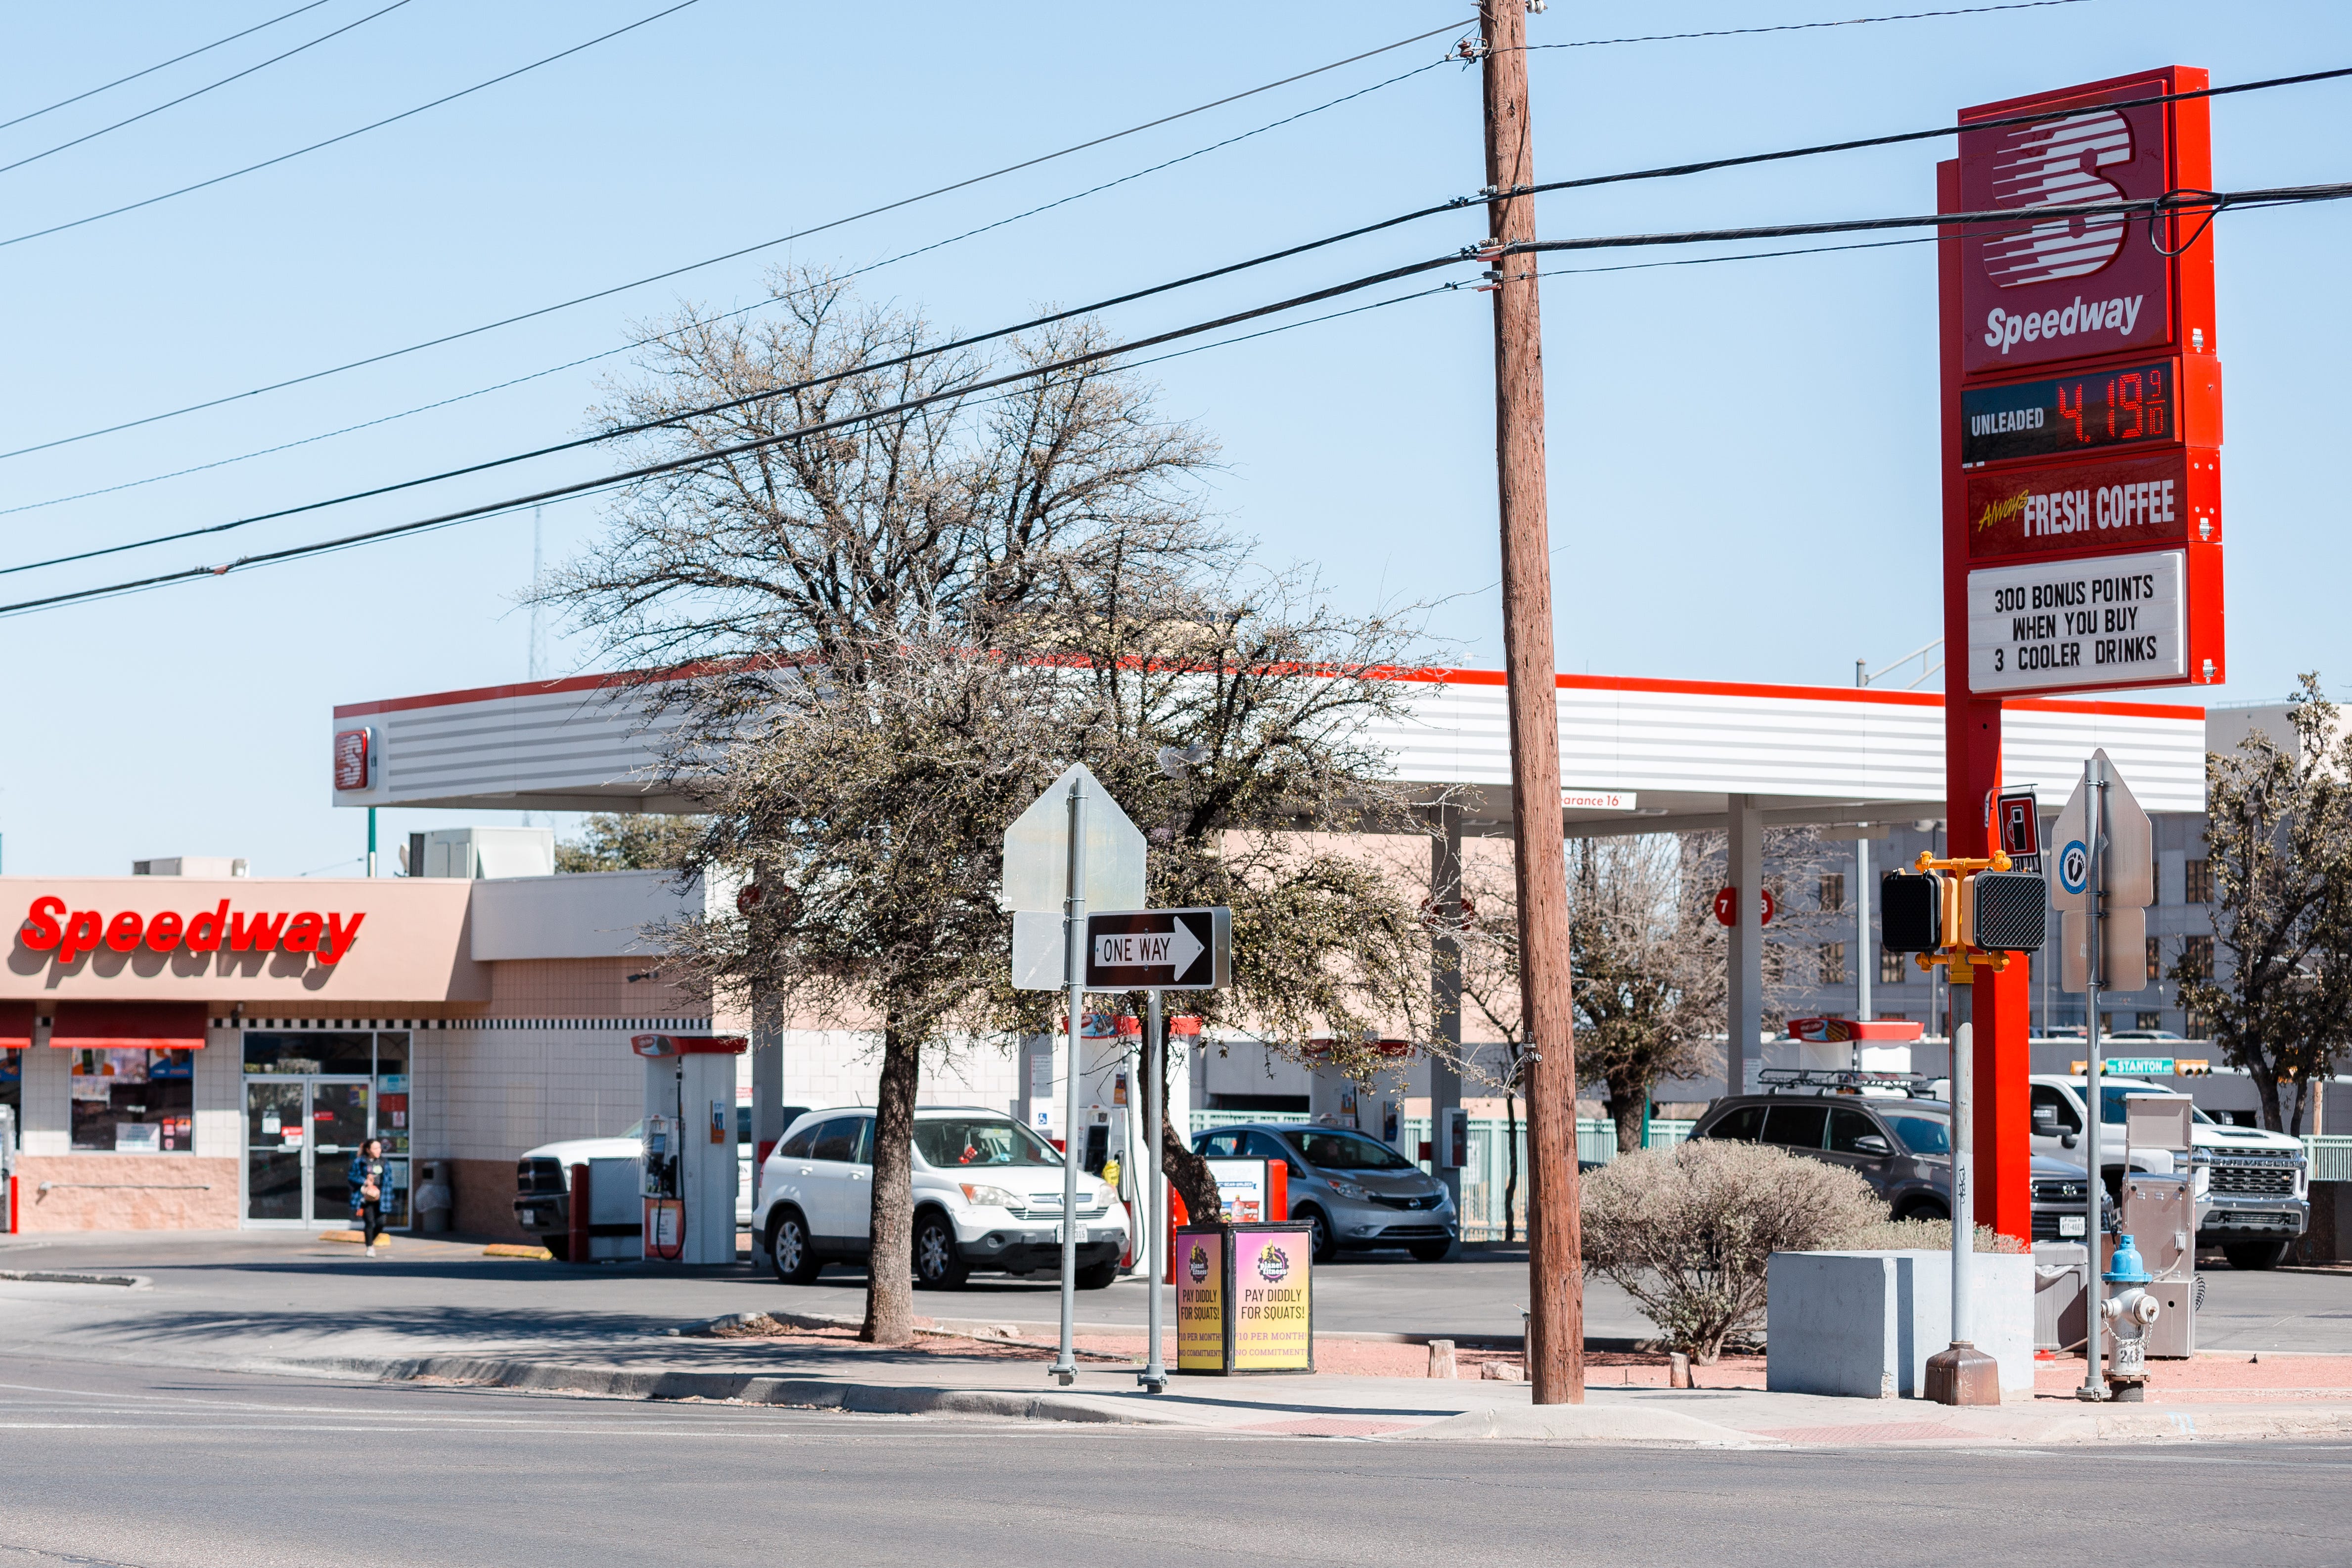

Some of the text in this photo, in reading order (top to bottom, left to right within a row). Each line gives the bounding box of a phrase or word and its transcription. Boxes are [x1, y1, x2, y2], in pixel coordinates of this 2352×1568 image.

[1985, 295, 2143, 354] Speedway
[1971, 372, 2143, 443] UNLEADED 4.19
[1978, 479, 2174, 537] Always FRESH COFFEE
[1994, 574, 2154, 613] 300 BONUS POINTS
[2013, 606, 2138, 642] WHEN YOU BUY
[1994, 635, 2157, 672] 3 COOLER DRINKS
[1561, 797, 1603, 806] arance
[2010, 856, 2039, 872] ELMAN
[1720, 899, 1728, 914] 7
[21, 896, 366, 965] Speedway
[1103, 938, 1171, 962] ONE WAY
[2118, 1060, 2163, 1073] STANTON
[1260, 1261, 1282, 1271] planet
[1182, 1290, 1217, 1302] PAY DIDDLY
[1245, 1290, 1302, 1302] PAY DIDDLY
[1181, 1306, 1220, 1321] FOR SQUATS!
[1241, 1306, 1305, 1320] FOR SQUATS!
